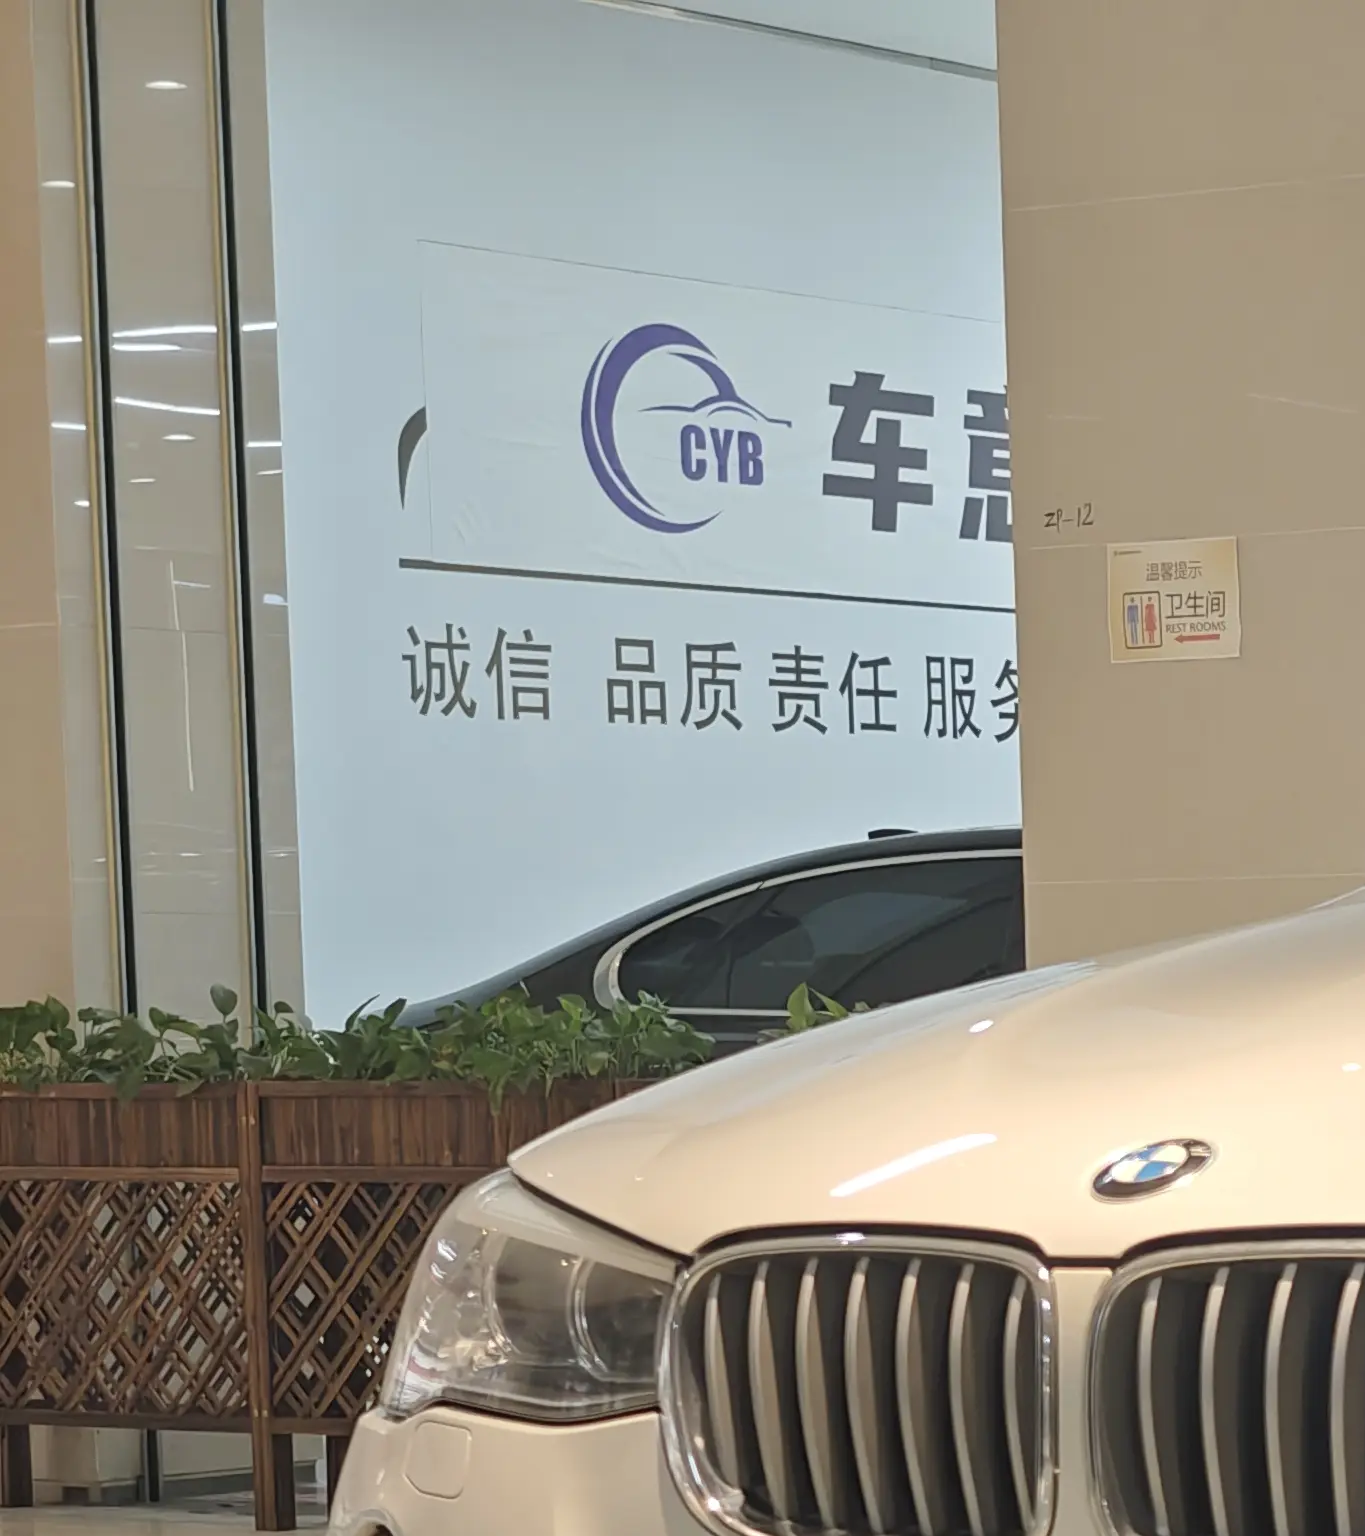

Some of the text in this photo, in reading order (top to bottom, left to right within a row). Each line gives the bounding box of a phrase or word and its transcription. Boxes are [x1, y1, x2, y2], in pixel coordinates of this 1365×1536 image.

[681, 424, 764, 485] CYB
[1165, 591, 1226, 619] 卫生间
[1166, 620, 1226, 634] REST ROOMS
[402, 622, 552, 720] 诚信
[607, 637, 743, 731] 品质
[769, 645, 897, 735] 责任
